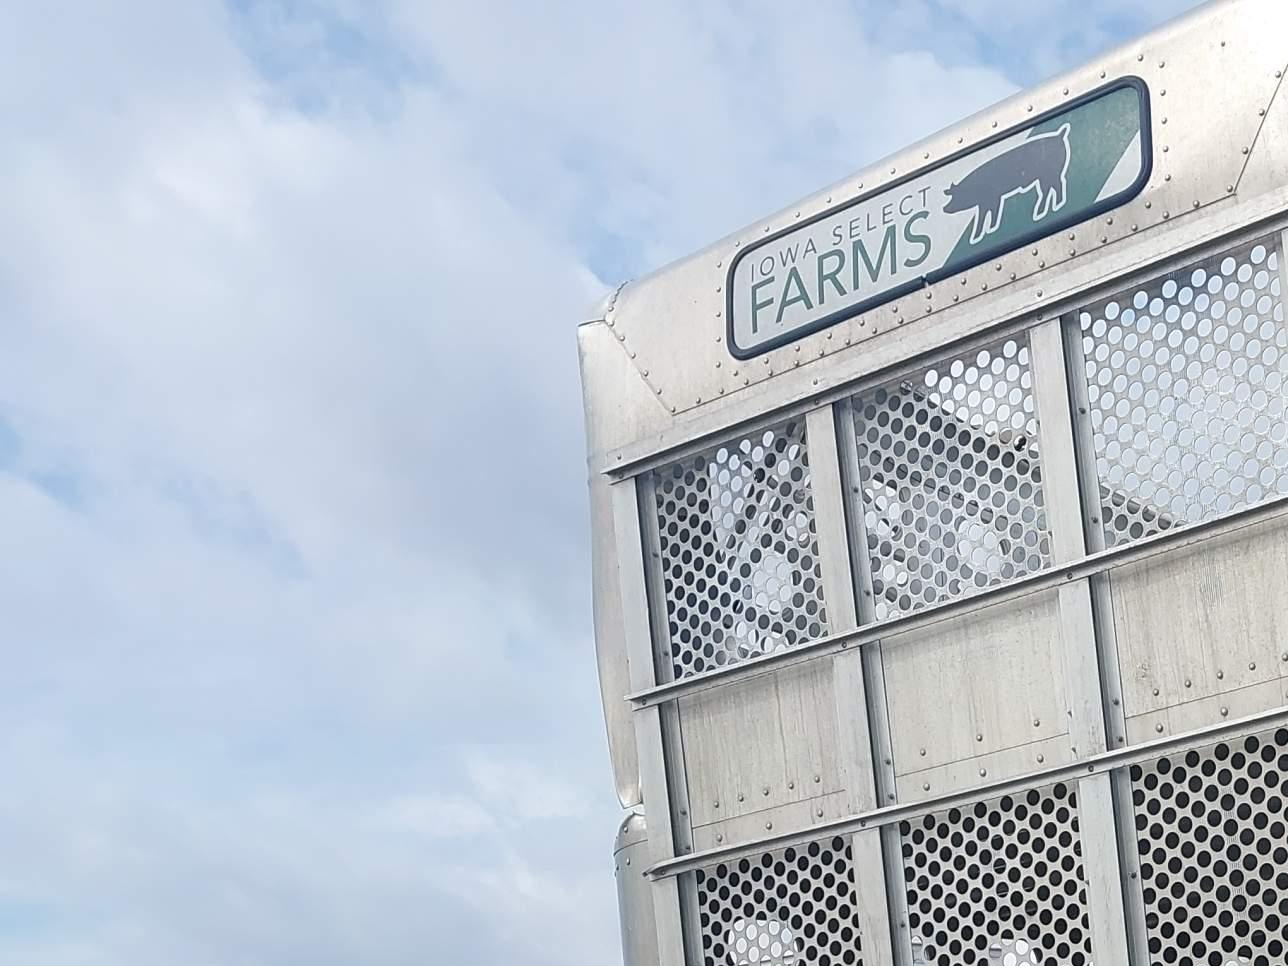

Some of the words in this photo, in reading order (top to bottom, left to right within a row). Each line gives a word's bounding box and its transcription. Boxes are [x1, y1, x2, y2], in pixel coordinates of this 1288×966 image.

[750, 236, 818, 281] IOWA
[832, 185, 931, 248] SELECT
[750, 211, 931, 334] FARMS
